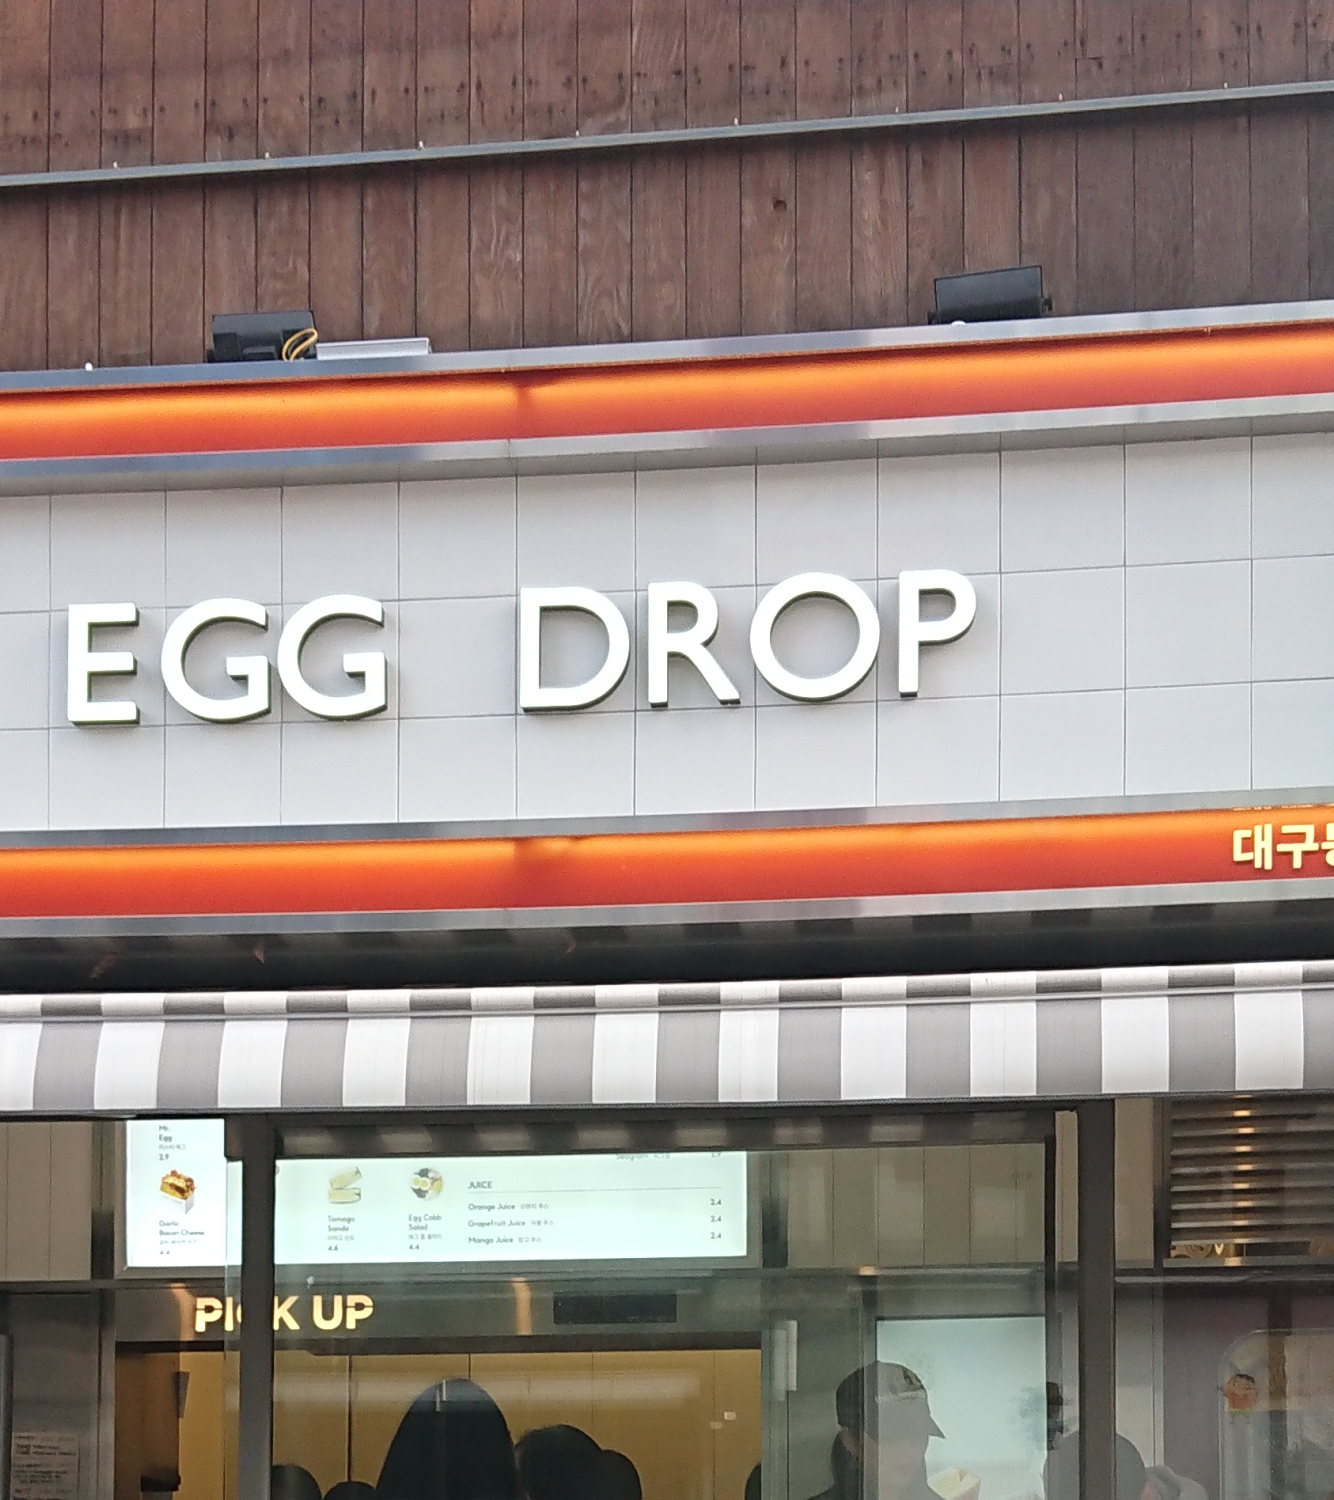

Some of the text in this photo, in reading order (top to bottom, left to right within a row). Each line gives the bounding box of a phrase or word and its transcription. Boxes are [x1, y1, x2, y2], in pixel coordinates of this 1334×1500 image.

[67, 569, 976, 726] EGG DROP
[467, 1181, 493, 1190] JUICE
[710, 1198, 722, 1206] 2.4
[468, 1203, 496, 1212] Orange
[497, 1203, 516, 1211] Juice
[408, 1213, 422, 1223] Egg
[408, 1223, 429, 1231] Salad
[468, 1220, 507, 1229] Grapefruit
[507, 1219, 526, 1227] Juice
[468, 1236, 494, 1245] Mango
[495, 1236, 514, 1244] Juice
[195, 1294, 374, 1332] PIK UP
